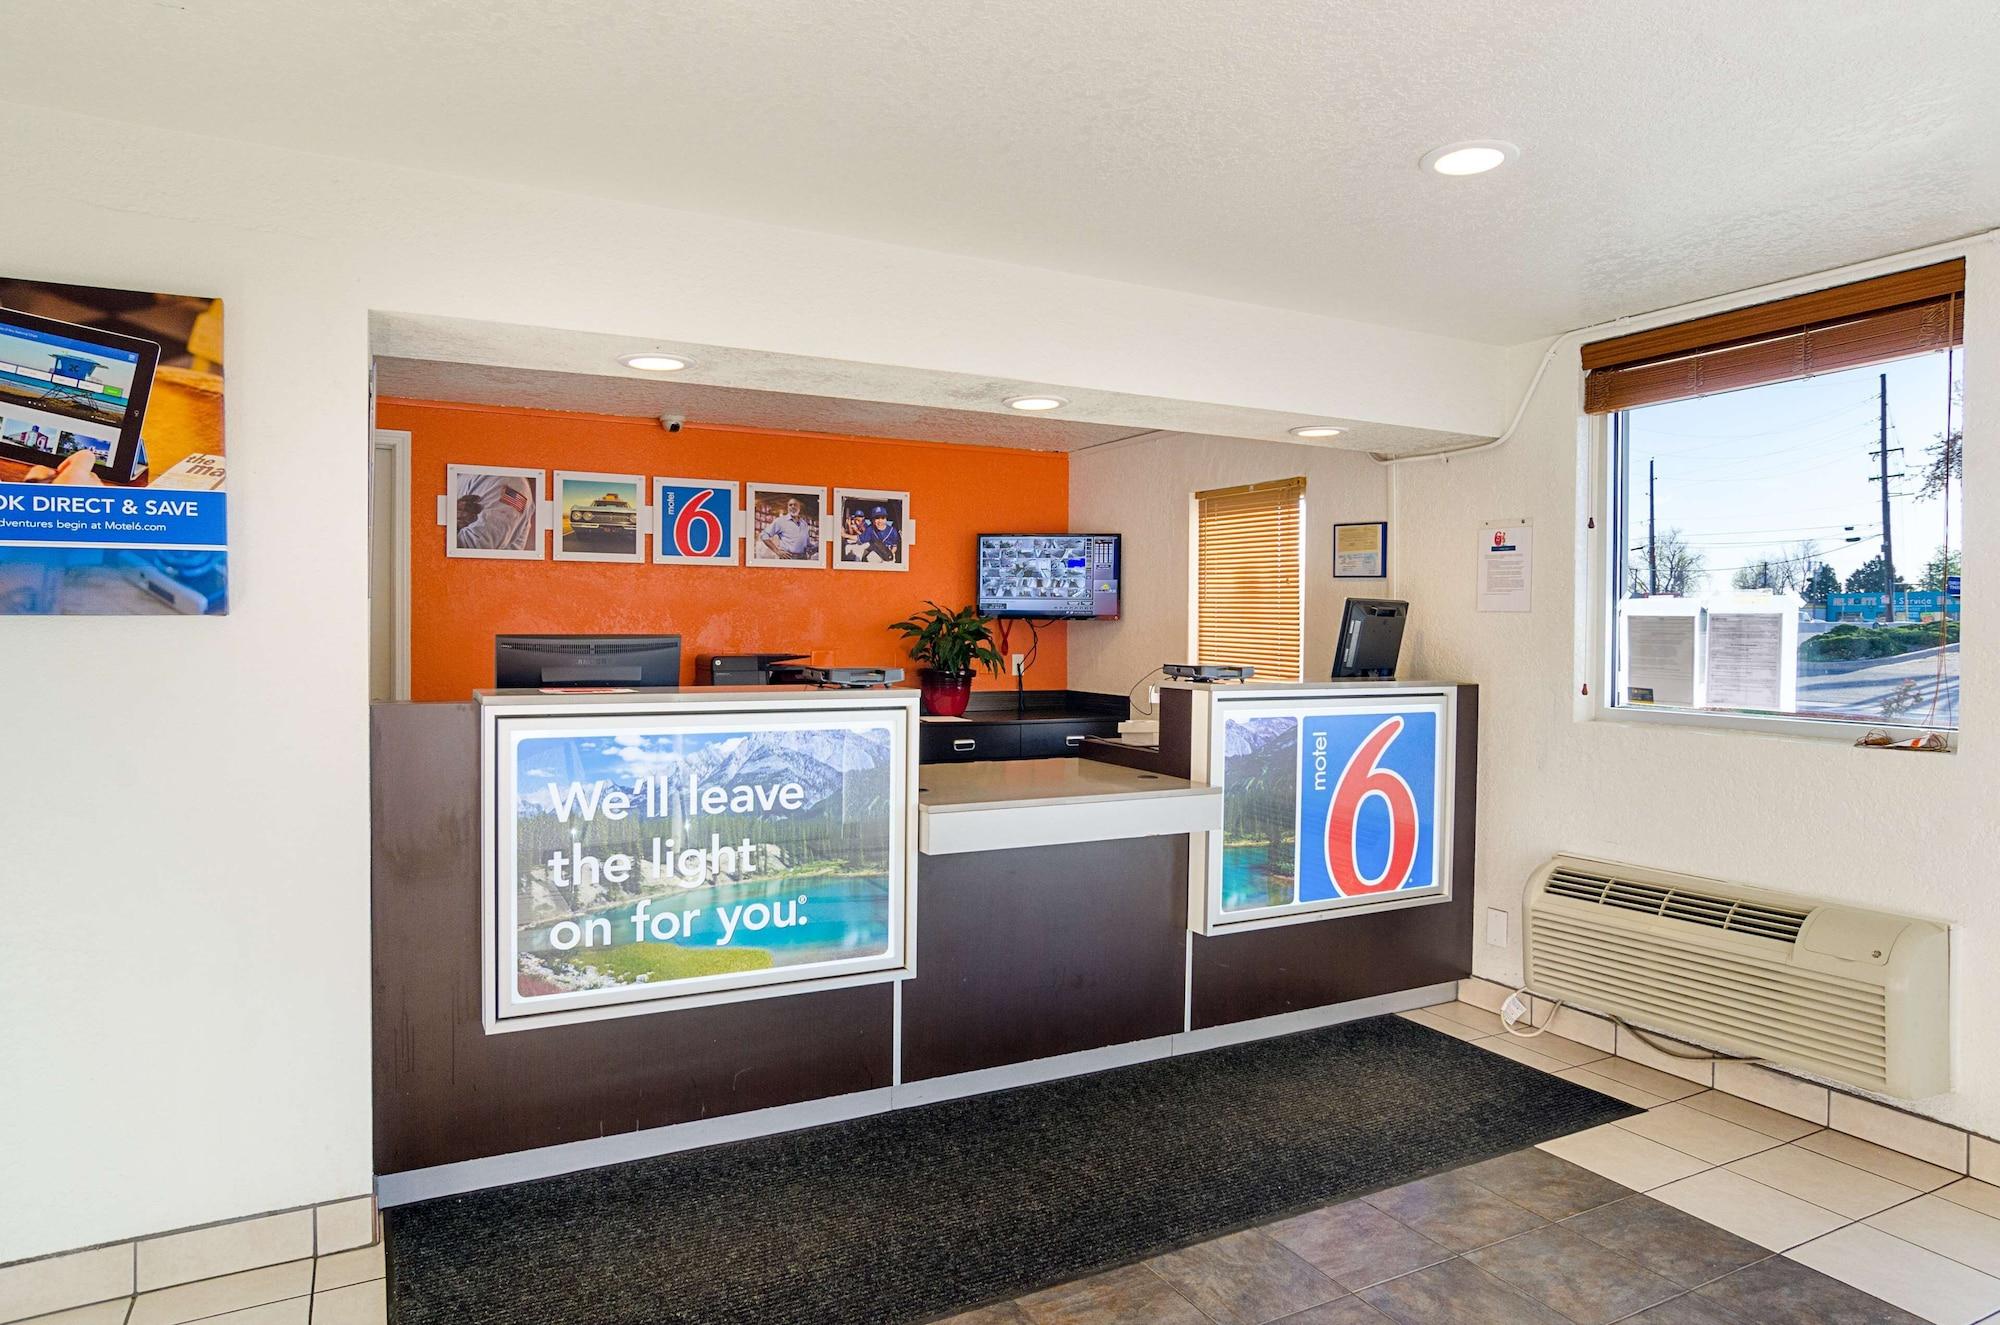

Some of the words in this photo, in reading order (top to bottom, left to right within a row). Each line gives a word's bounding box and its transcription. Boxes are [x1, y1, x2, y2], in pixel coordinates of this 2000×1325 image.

[186, 454, 215, 465] the
[33, 496, 115, 514] DIRECT
[121, 499, 138, 515] &
[145, 499, 198, 517] SAVE
[56, 520, 87, 531] begin
[91, 521, 101, 530] at
[105, 521, 167, 532] Motel6.com
[667, 492, 675, 515] motel
[673, 489, 723, 558] 6
[547, 774, 669, 823] We'll
[689, 774, 804, 816] leave
[1312, 731, 1327, 791] motel
[1324, 715, 1419, 898] 6
[548, 842, 631, 888] the
[652, 833, 757, 889] light
[549, 916, 612, 951] on
[631, 899, 701, 943] for
